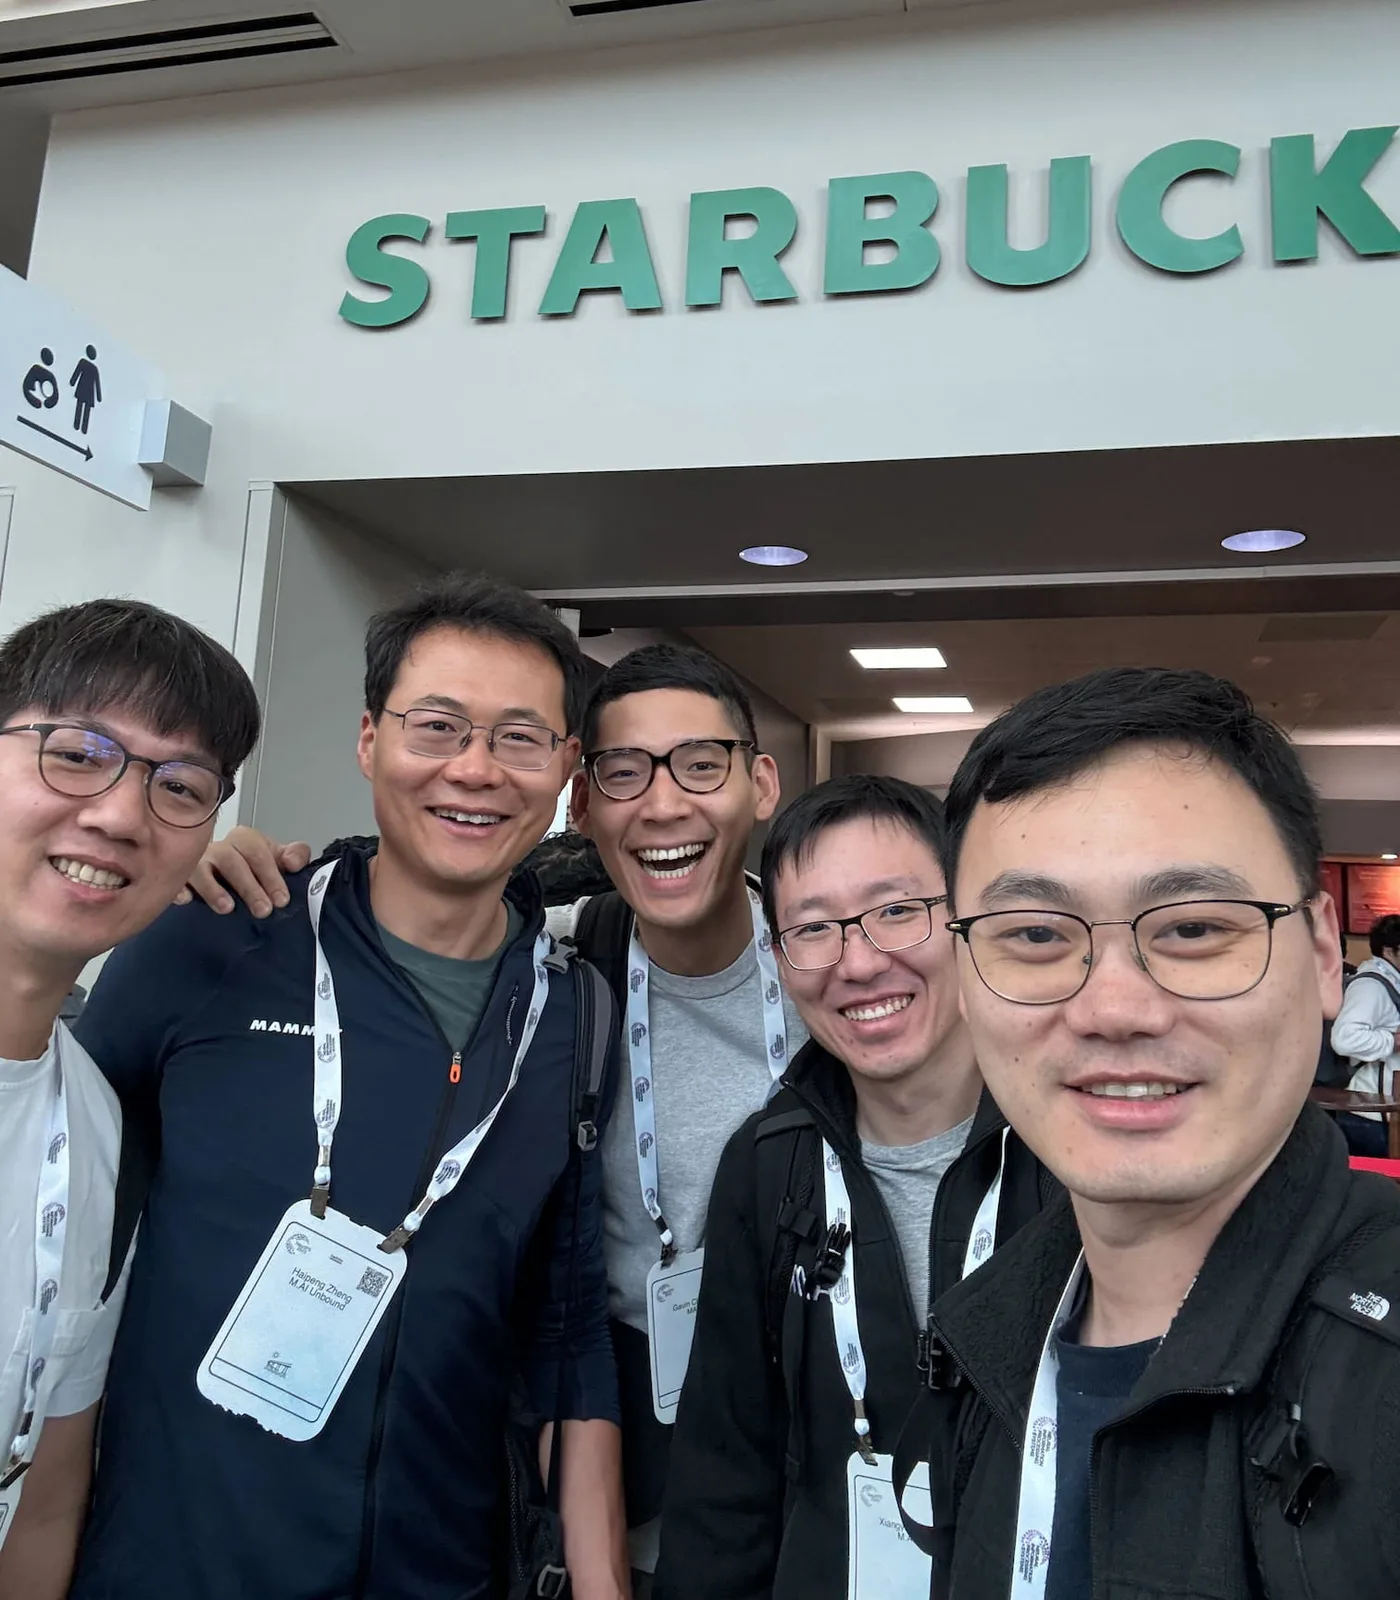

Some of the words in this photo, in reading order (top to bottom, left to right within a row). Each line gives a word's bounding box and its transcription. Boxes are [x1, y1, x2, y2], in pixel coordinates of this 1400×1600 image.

[338, 125, 1400, 327] STARBUCK
[249, 1019, 343, 1036] MAMM
[292, 1266, 326, 1291] Haipeng
[326, 1283, 352, 1305] Zheng
[309, 1287, 346, 1311] Unbound
[1349, 1292, 1375, 1309] NORTH
[1366, 1291, 1383, 1304] THE
[672, 1301, 690, 1312] Gavin
[1350, 1301, 1373, 1316] FACE
